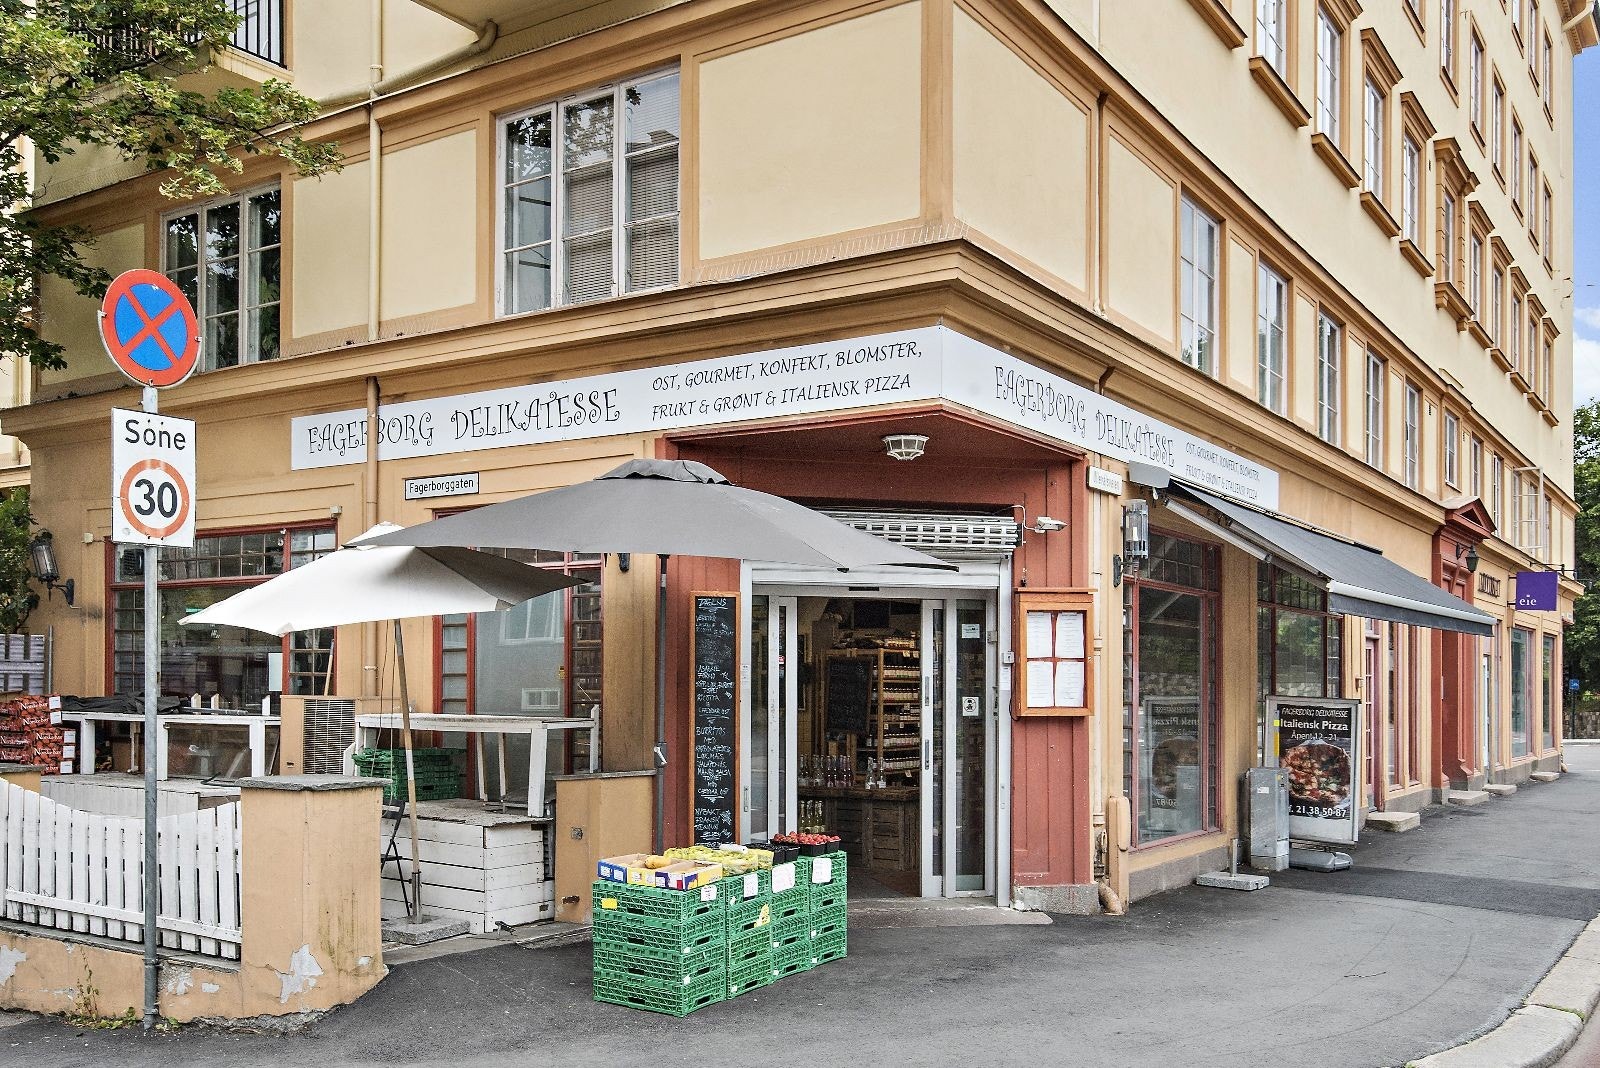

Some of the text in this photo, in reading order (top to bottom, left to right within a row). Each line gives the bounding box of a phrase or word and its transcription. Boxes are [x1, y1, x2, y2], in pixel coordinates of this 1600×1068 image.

[652, 341, 923, 391] OST, GOURMET, KONFEKT, BLOMSTER,
[450, 388, 621, 440] DELIKATESSE
[652, 373, 912, 421] FRUKT & GRØNT & ITALIENSK PIZZA
[995, 366, 1175, 467] FAGERBORG DELIKATESSE
[134, 478, 178, 518] 30
[409, 478, 474, 495] Fagerborggaten
[1519, 594, 1537, 606] eie
[1280, 718, 1349, 731] Italiensk Pizza
[1296, 805, 1306, 814] 21
[1308, 806, 1320, 815] 38
